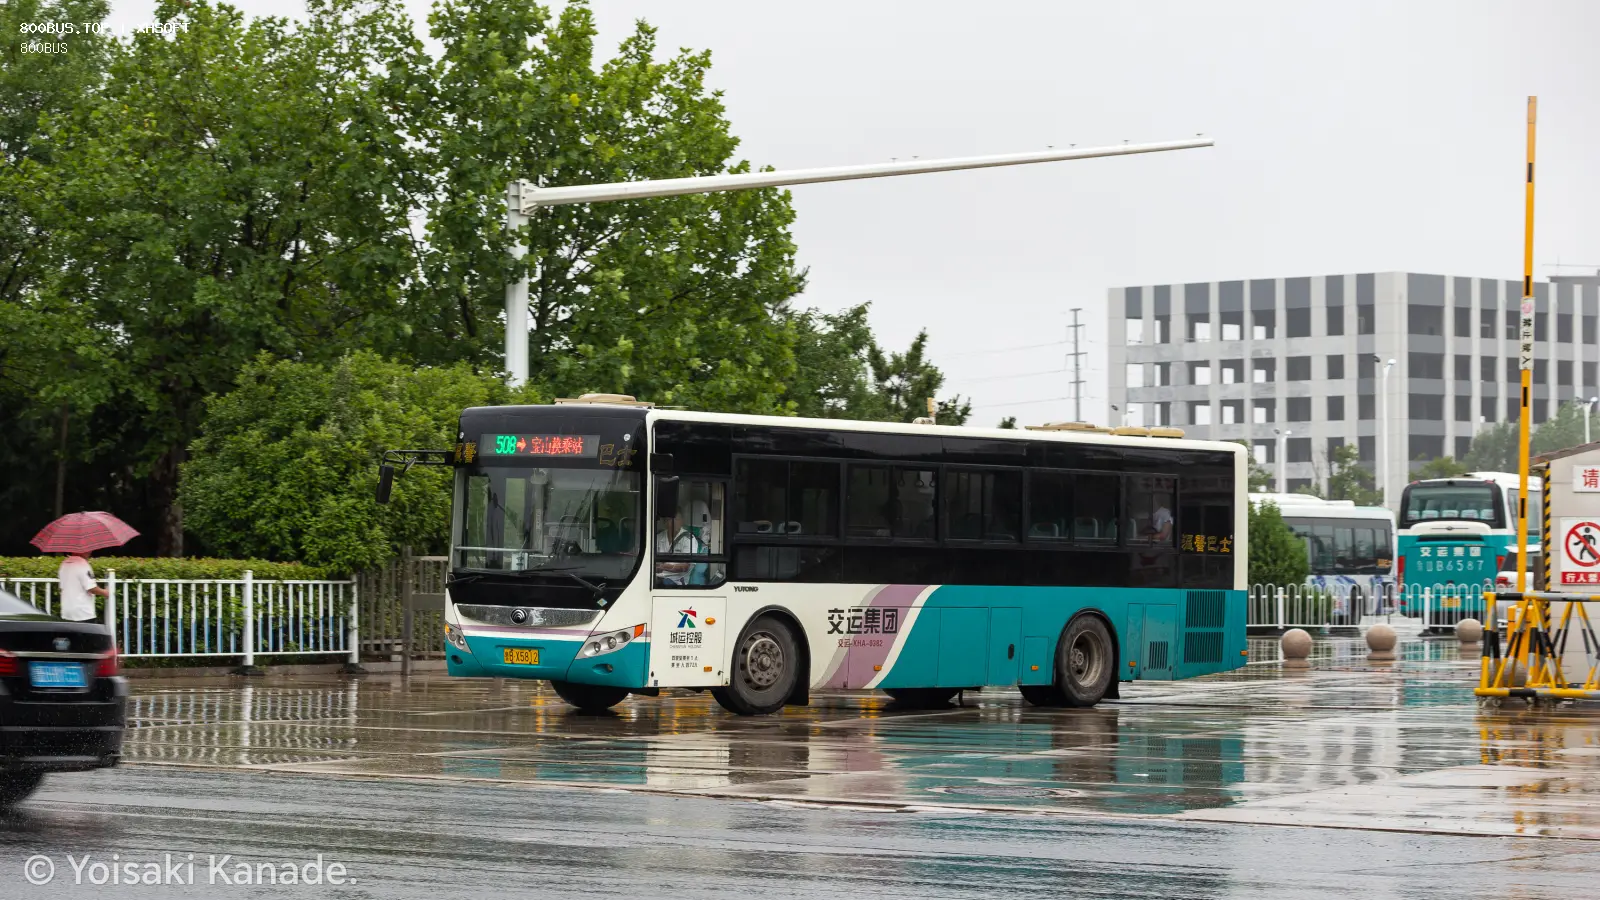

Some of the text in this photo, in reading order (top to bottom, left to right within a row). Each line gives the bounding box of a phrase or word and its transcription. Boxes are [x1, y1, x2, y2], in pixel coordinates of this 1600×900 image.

[495, 435, 584, 455] 508 宝山换乘站
[599, 443, 637, 466] 巴士
[1582, 468, 1600, 489] 请
[1420, 546, 1482, 557] 交运集团
[733, 585, 759, 593] YUTONG
[827, 608, 899, 635] 交运集团
[669, 631, 703, 644] 城运控股
